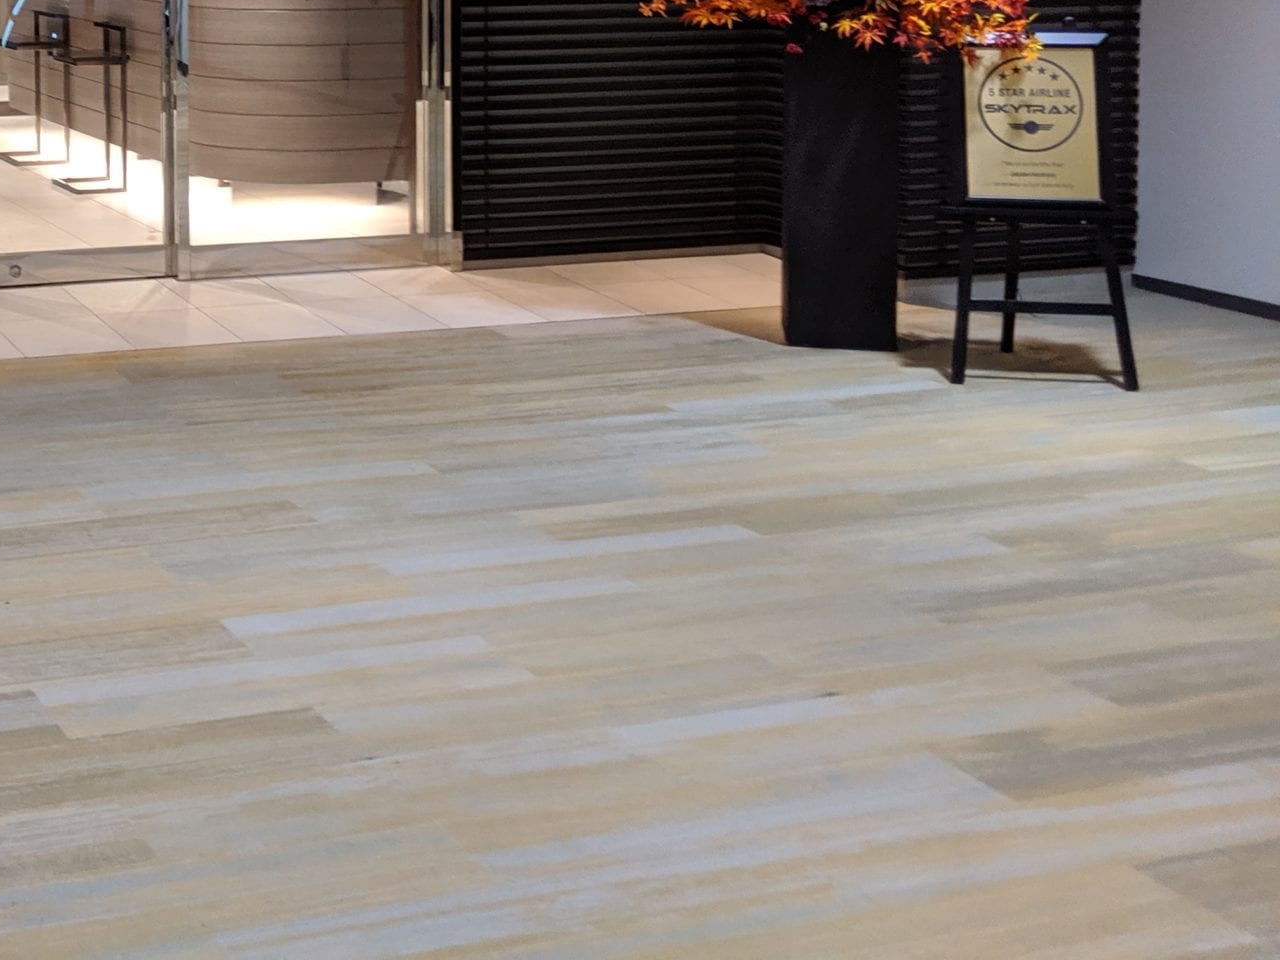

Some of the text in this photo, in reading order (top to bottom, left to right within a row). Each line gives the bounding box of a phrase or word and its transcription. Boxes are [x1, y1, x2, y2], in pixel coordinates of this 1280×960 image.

[988, 88, 1071, 98] 5 STAR AIRLINE
[984, 103, 1078, 115] SKYTRAX
